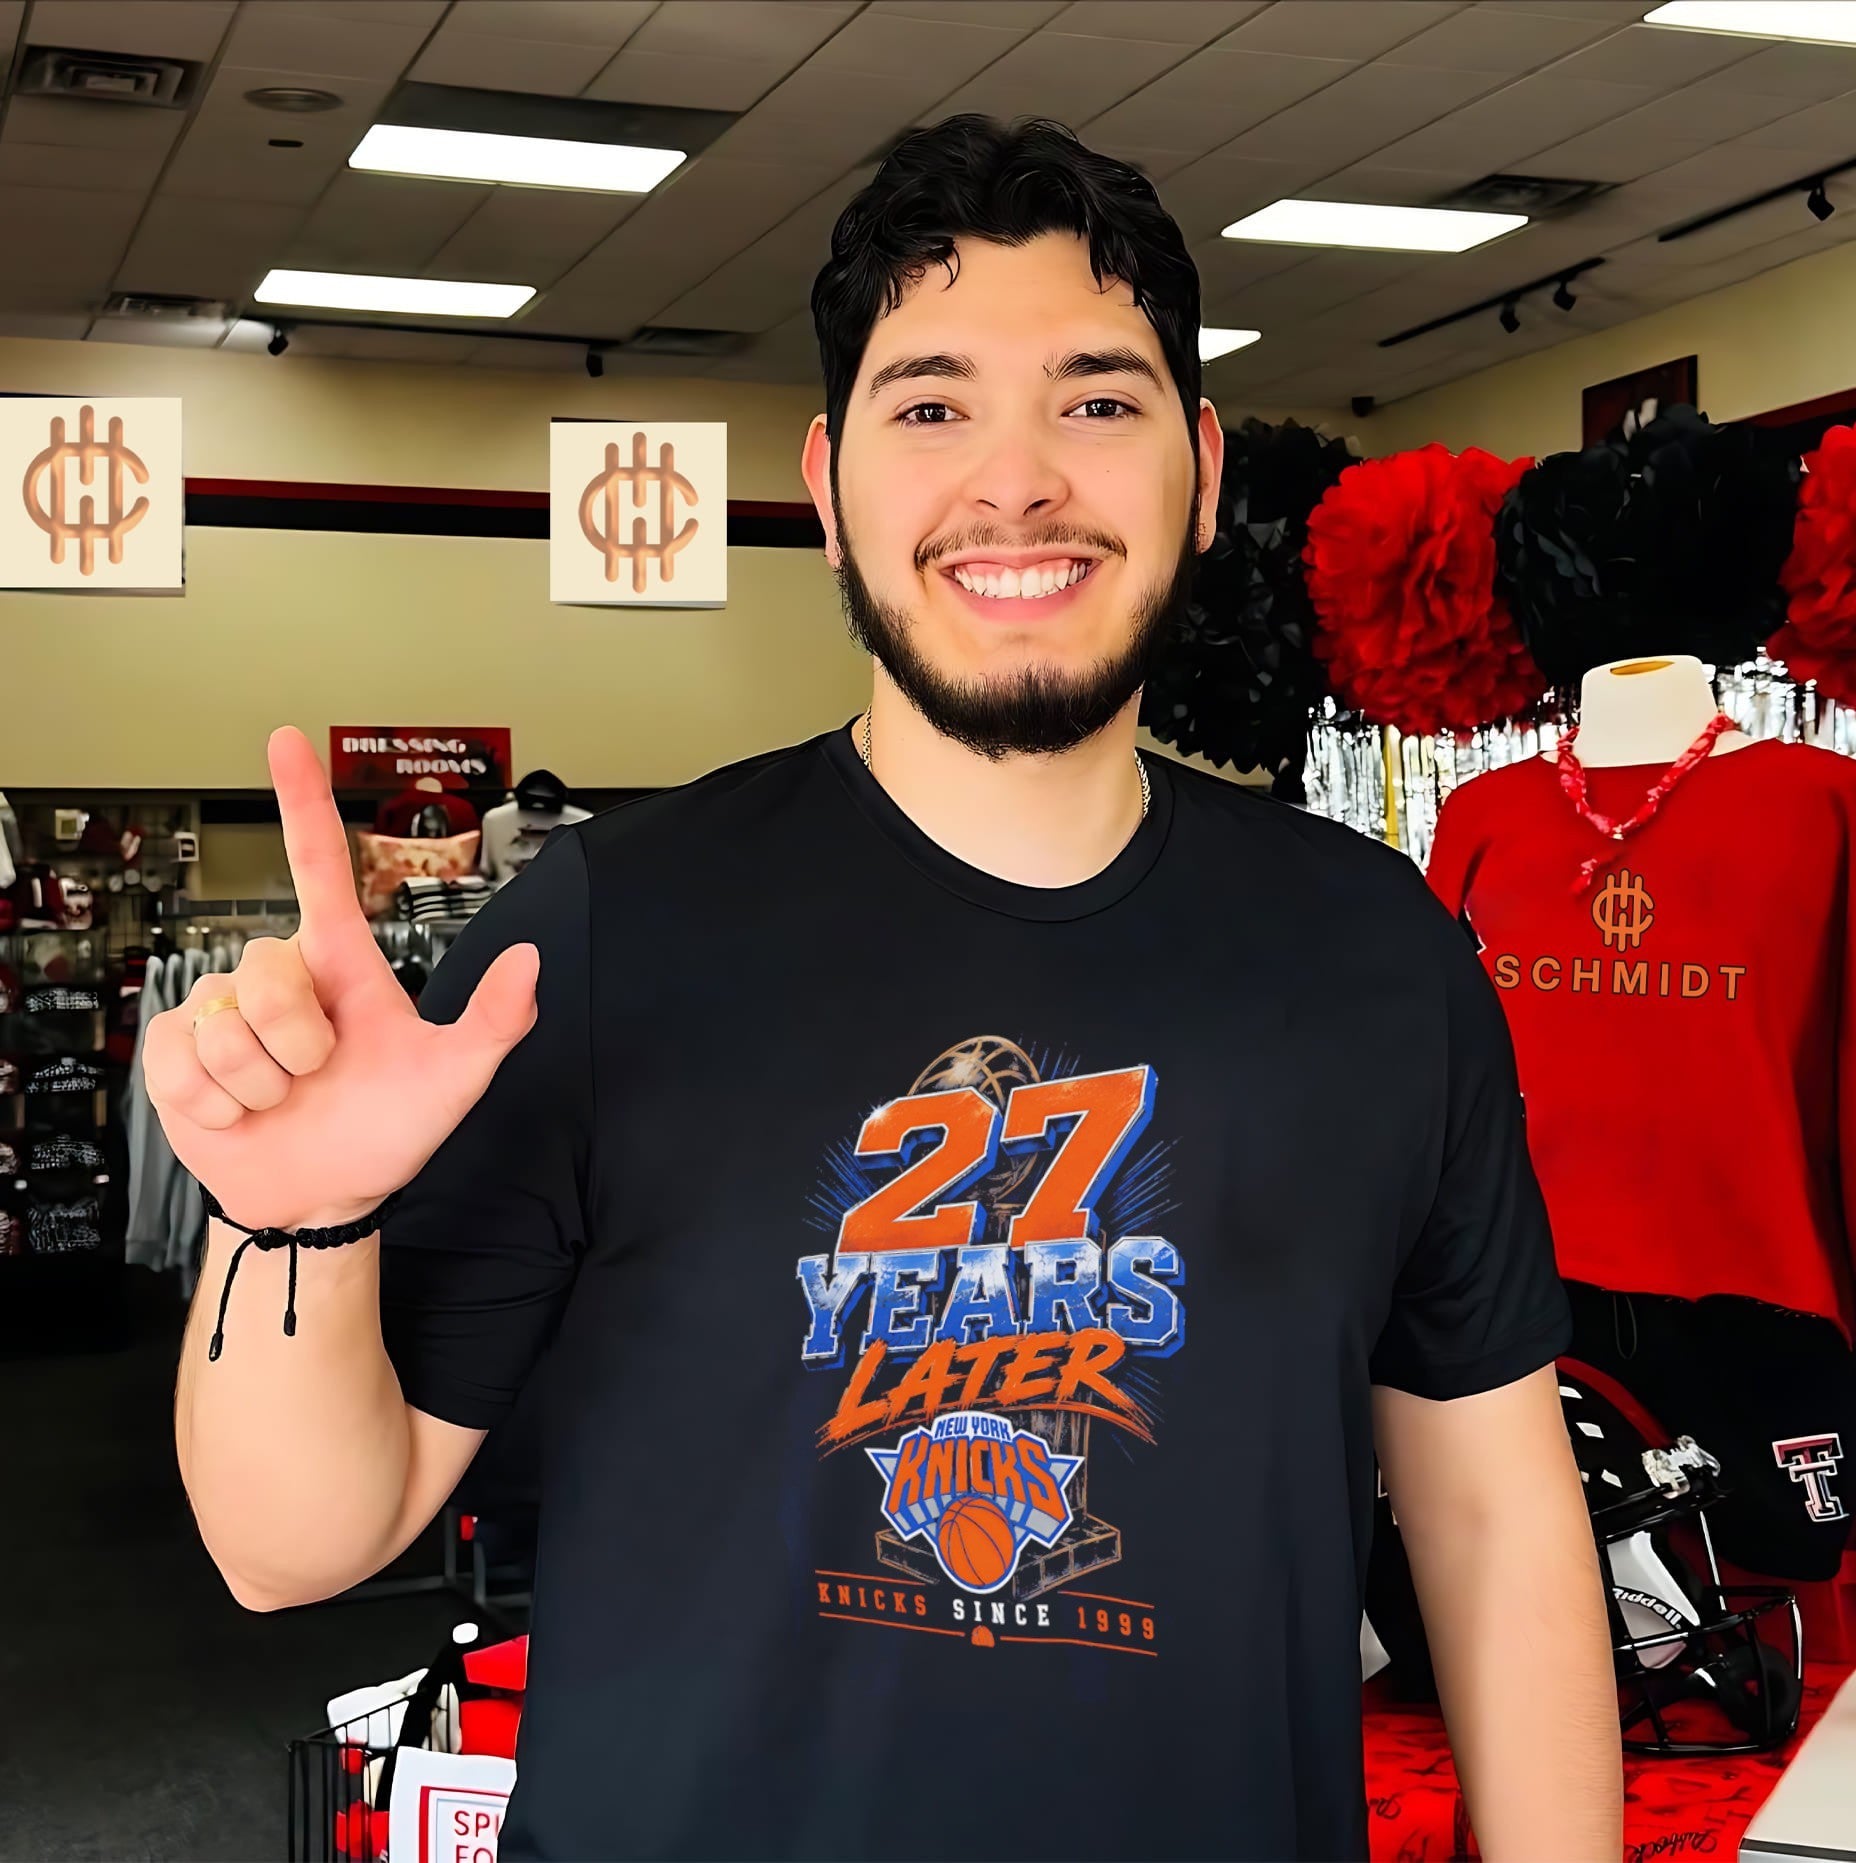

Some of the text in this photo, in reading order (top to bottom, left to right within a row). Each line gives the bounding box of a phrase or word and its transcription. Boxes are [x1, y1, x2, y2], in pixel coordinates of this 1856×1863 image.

[396, 758, 487, 775] ROOMS
[1494, 954, 1746, 1000] SCHMIDT
[837, 1064, 1158, 1252] 27
[796, 1236, 1186, 1368] YEARS
[816, 1328, 1156, 1442] LATER
[934, 1416, 1012, 1441] NEW YORK
[887, 1432, 1067, 1521] KNICKS
[817, 1582, 1156, 1641] KNICKS SINCE 1999
